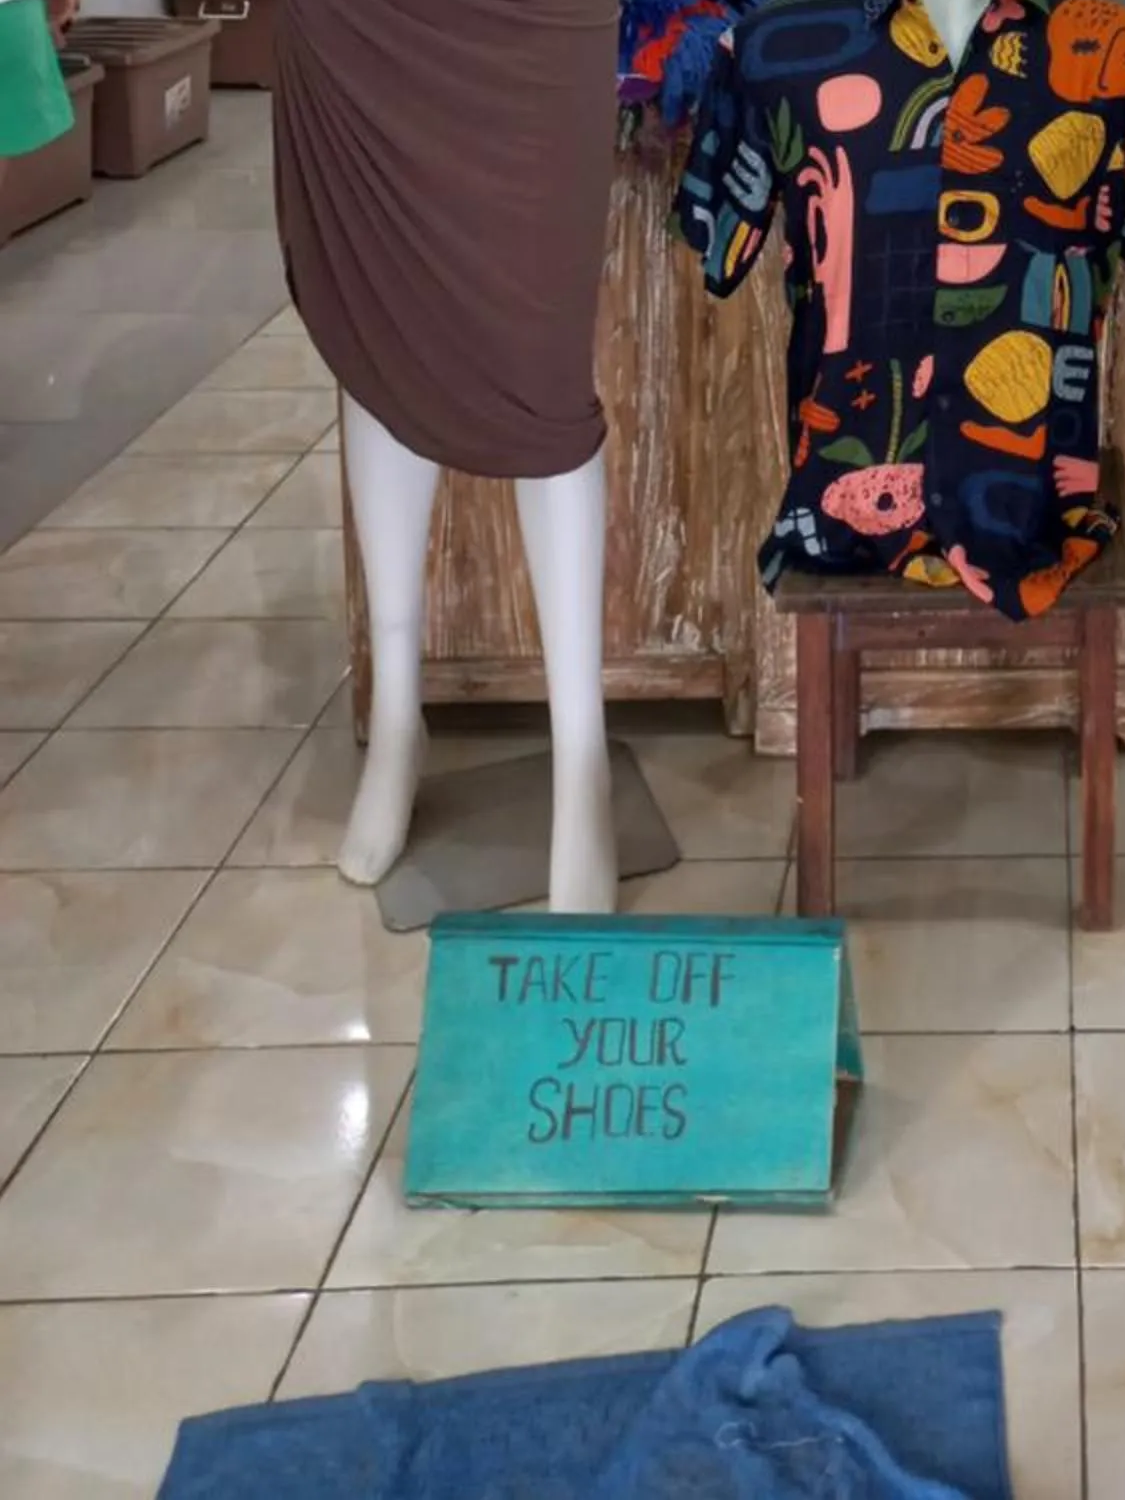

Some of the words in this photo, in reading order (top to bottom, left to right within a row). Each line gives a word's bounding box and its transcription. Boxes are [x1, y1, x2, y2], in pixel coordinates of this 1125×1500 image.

[488, 950, 613, 1003] TAKE
[650, 950, 736, 1007] OFF
[556, 1017, 687, 1070] YOUR
[527, 1076, 688, 1143] SHOES
